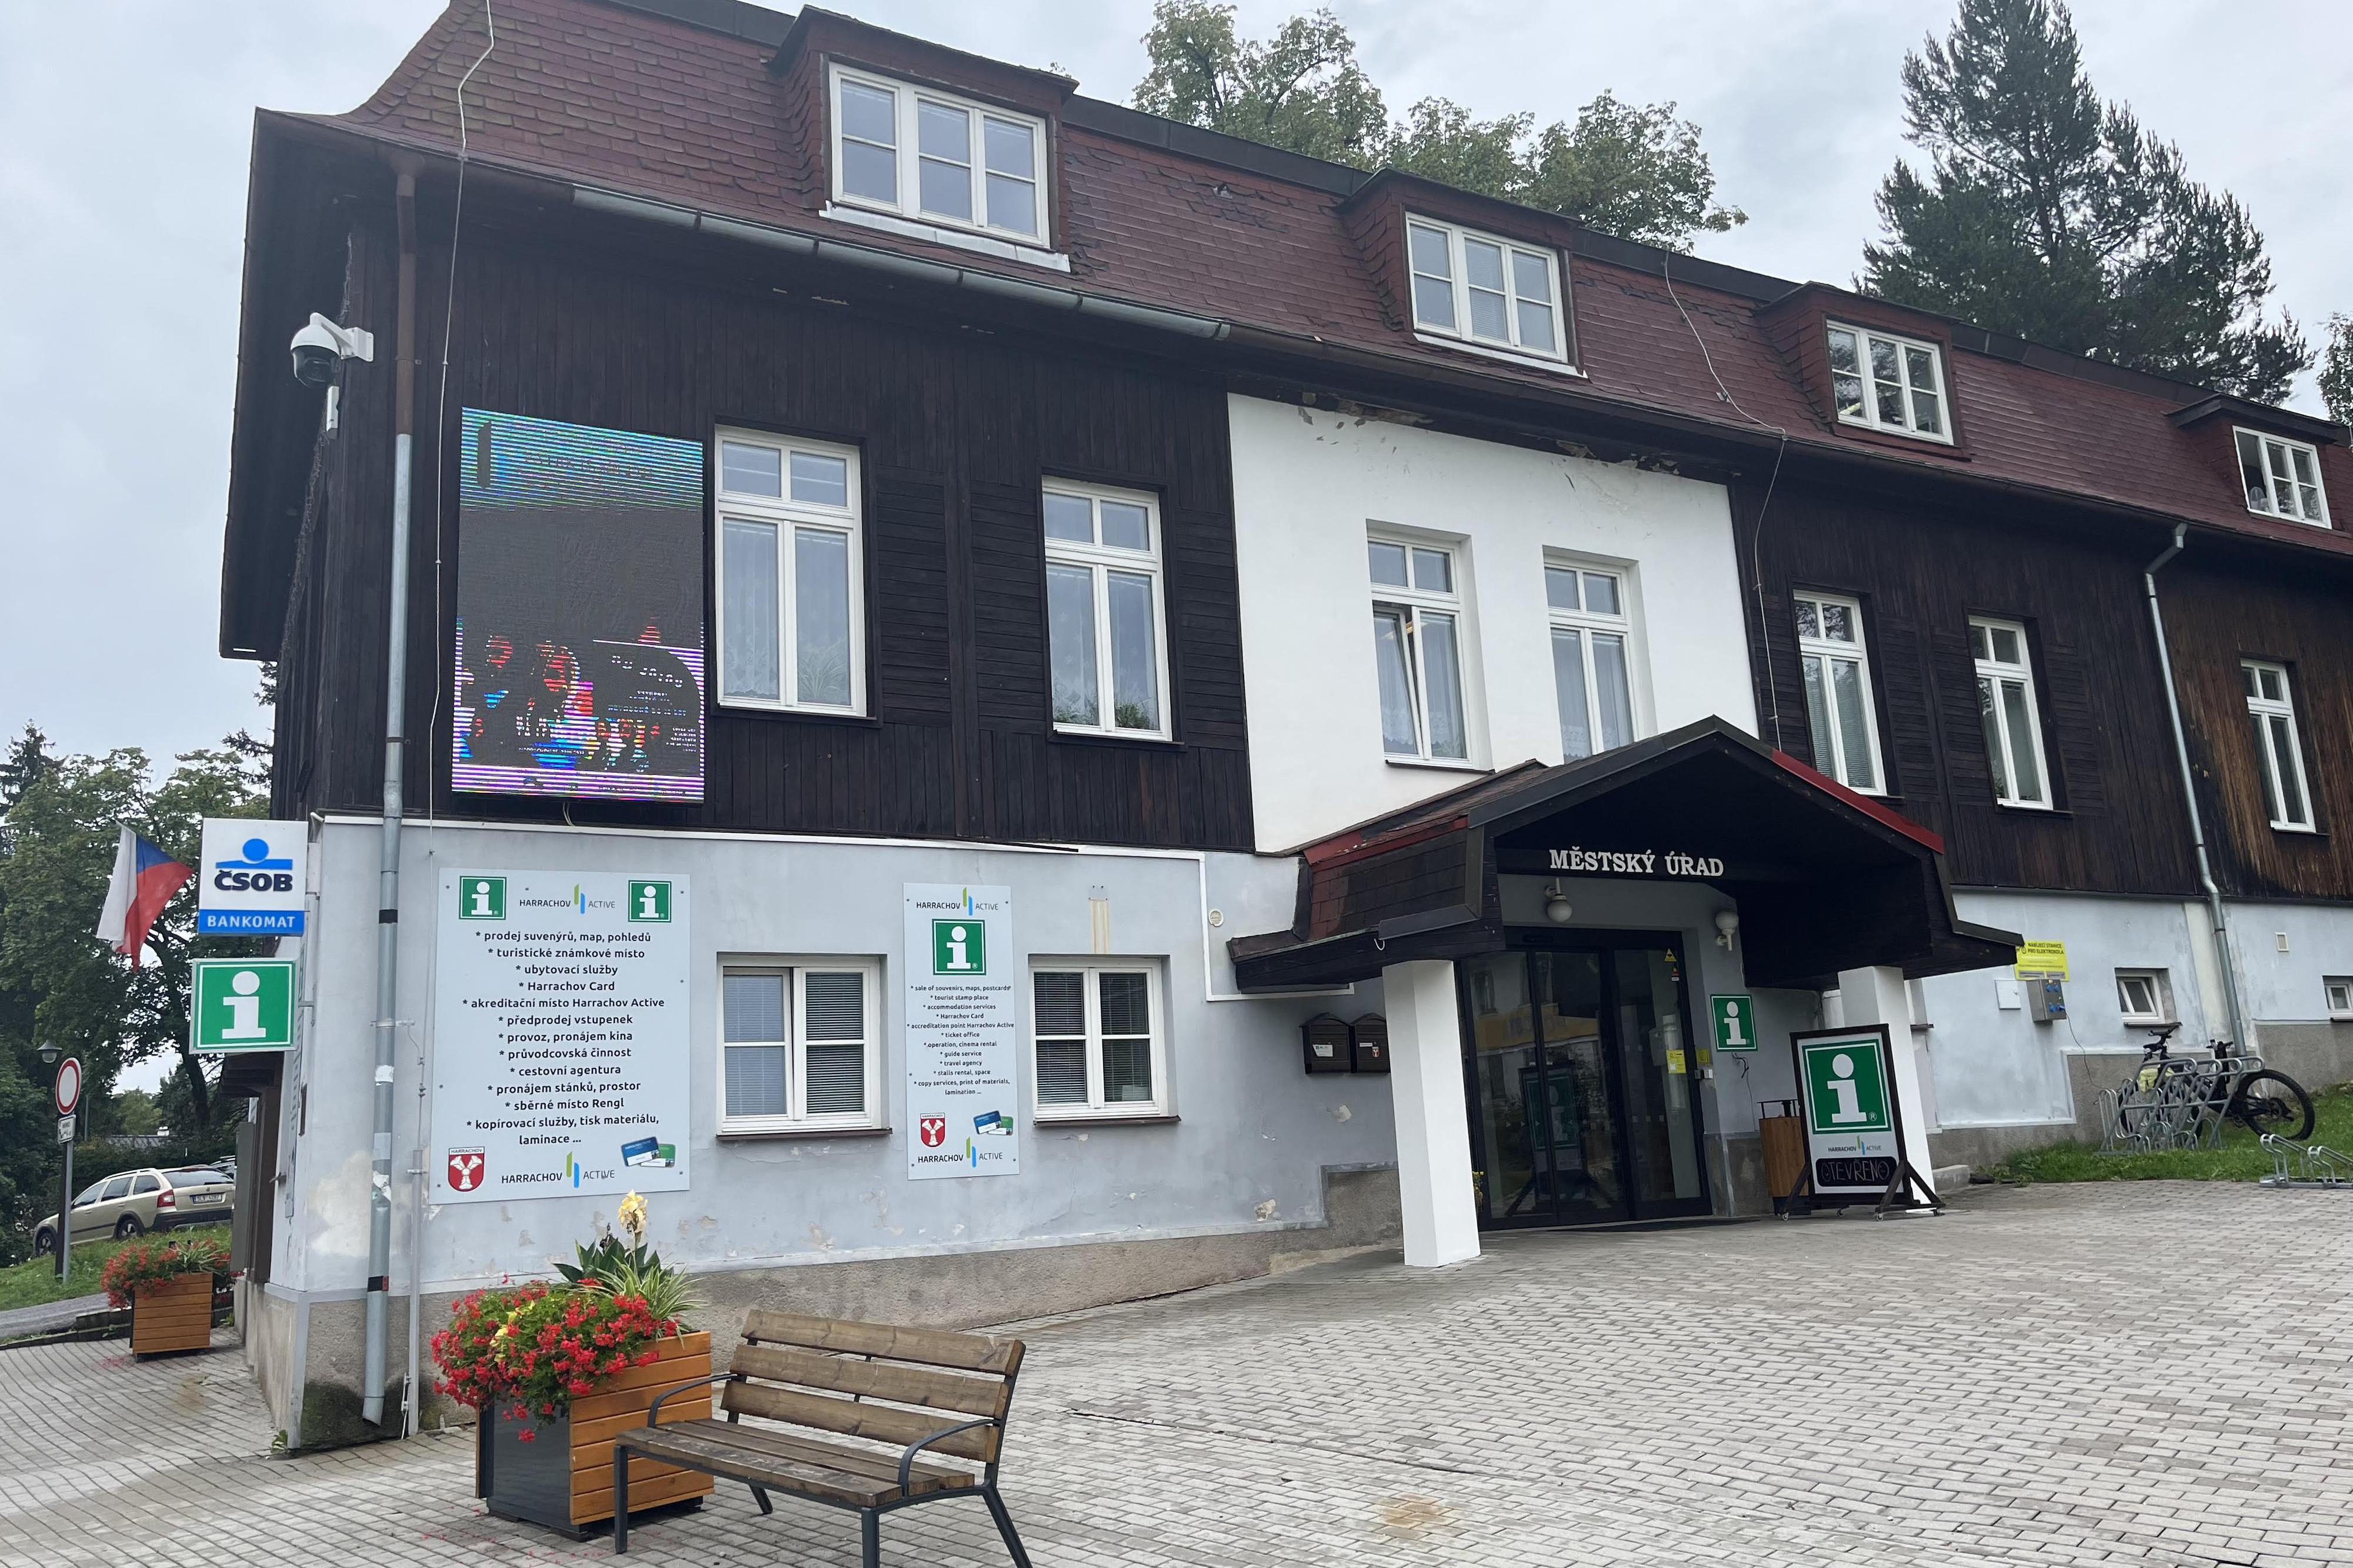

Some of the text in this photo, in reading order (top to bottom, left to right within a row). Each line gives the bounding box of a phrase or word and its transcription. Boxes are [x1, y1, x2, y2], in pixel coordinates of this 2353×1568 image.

[1549, 846, 1655, 873] MĚSTSKÝ
[214, 870, 293, 892] ČSOB
[519, 899, 616, 909] HARRACHOV ACTIVE
[916, 901, 999, 910] HARRACHOV ACTIVE
[207, 915, 295, 928] BANKOMAT
[484, 930, 651, 943] prodej suvenýrů, map, pohledů
[497, 948, 645, 958] turistické známkové místo
[524, 965, 618, 976] ubytovací služby
[528, 982, 615, 991] Harrachov Card
[471, 997, 665, 1008] akreditační místo Harrachov Active
[507, 1014, 633, 1027] předprodej vstupenek
[507, 1030, 633, 1043] provoz, pronájem kina
[508, 1047, 632, 1060] průvodcovská činnost
[518, 1065, 621, 1077] cestovní agentura
[496, 1082, 641, 1096] pronájem stánků, prostor
[514, 1097, 625, 1110] sběrné místo Rengl
[475, 1113, 659, 1130] kopírovací služby, tisk materiálu,
[519, 1135, 570, 1145] laminace
[918, 1152, 1003, 1163] HARRACHOV ACTIVE
[501, 1169, 615, 1183] HARRACHOV ACTIVE
[1821, 1159, 1889, 1182] OTEVŘENO
